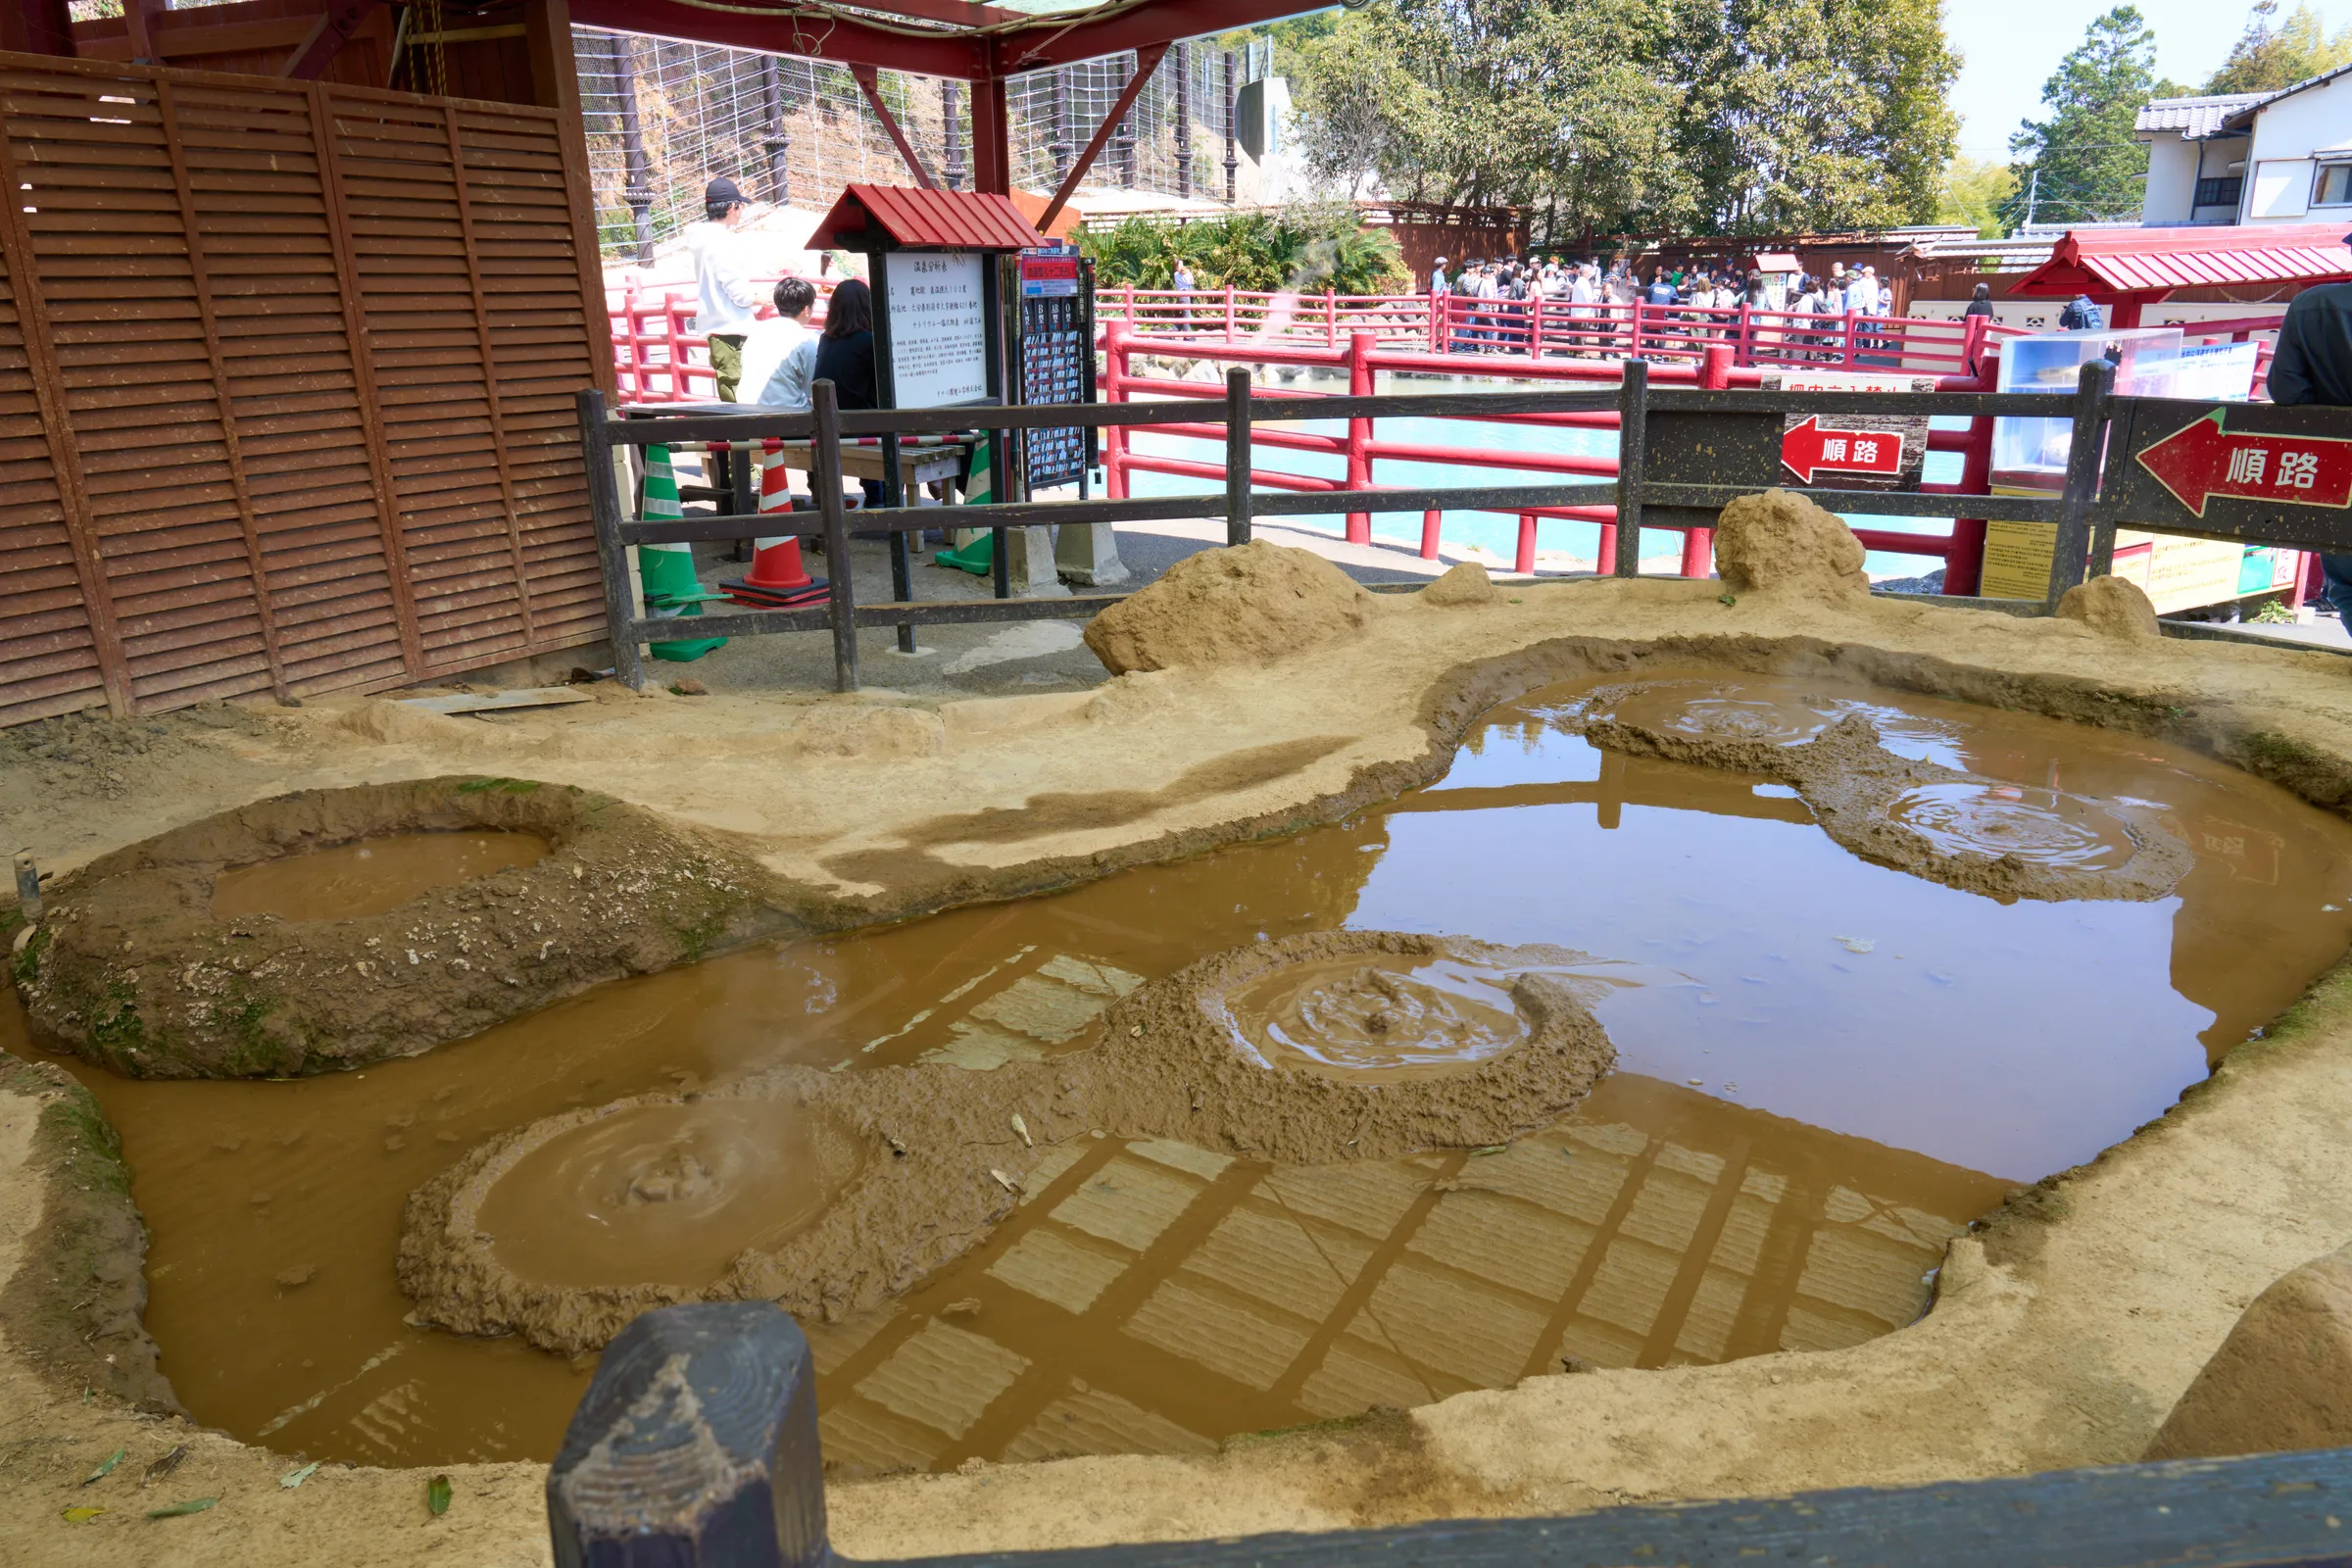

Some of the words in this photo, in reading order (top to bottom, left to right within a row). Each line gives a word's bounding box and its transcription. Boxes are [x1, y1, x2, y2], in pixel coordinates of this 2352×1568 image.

[913, 259, 948, 273] 温泉分析表
[1821, 438, 1879, 465] 順路
[2225, 447, 2319, 489] 順路
